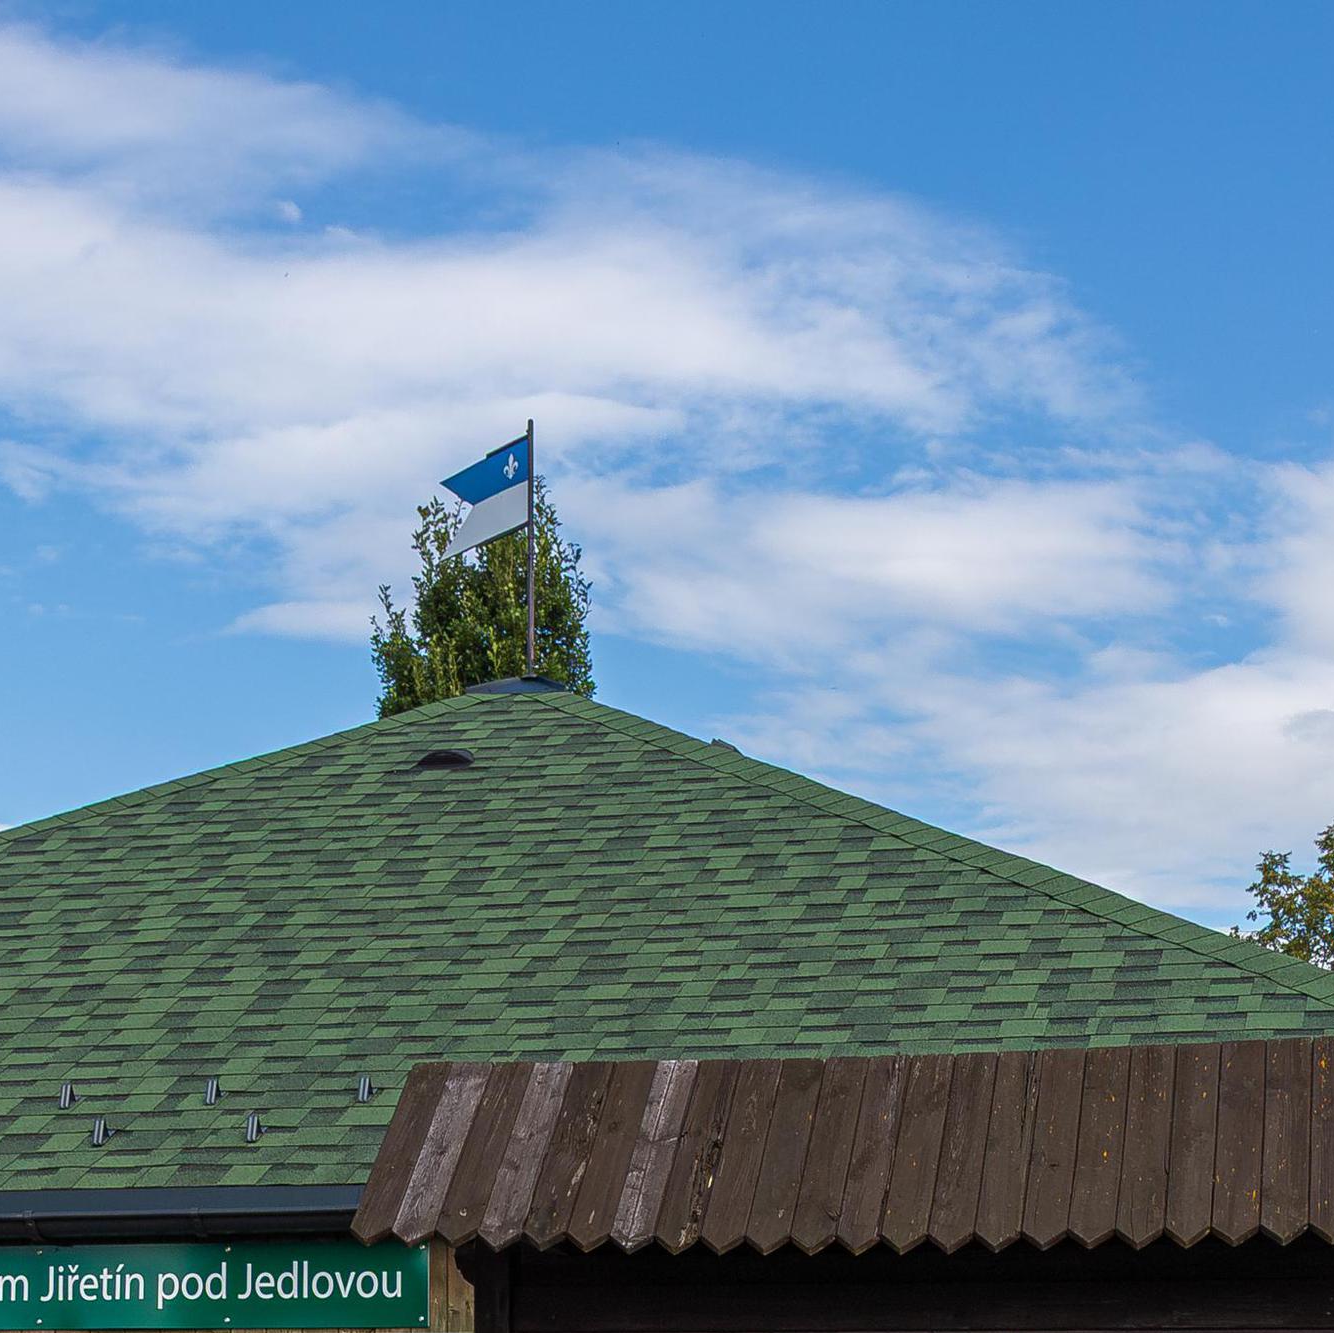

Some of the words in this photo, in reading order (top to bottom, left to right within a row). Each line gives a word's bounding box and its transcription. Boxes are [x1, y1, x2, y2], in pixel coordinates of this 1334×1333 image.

[40, 1263, 145, 1302] Jiřetín
[157, 1261, 227, 1310] pod
[237, 1260, 402, 1300] Jedlovou
